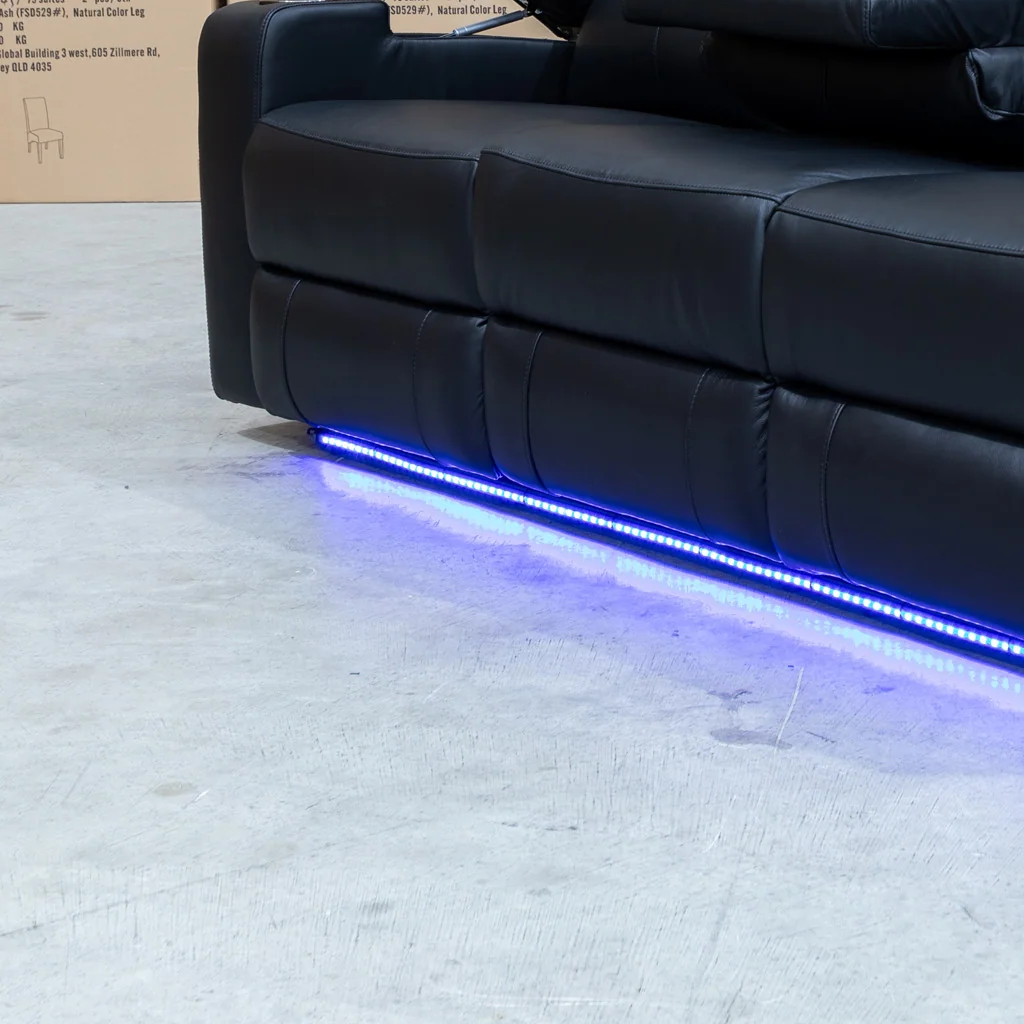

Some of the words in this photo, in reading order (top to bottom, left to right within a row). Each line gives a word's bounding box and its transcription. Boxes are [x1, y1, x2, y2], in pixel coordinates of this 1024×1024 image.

[73, 7, 105, 17] Natural
[106, 7, 129, 17] Color
[130, 6, 145, 18] Leg
